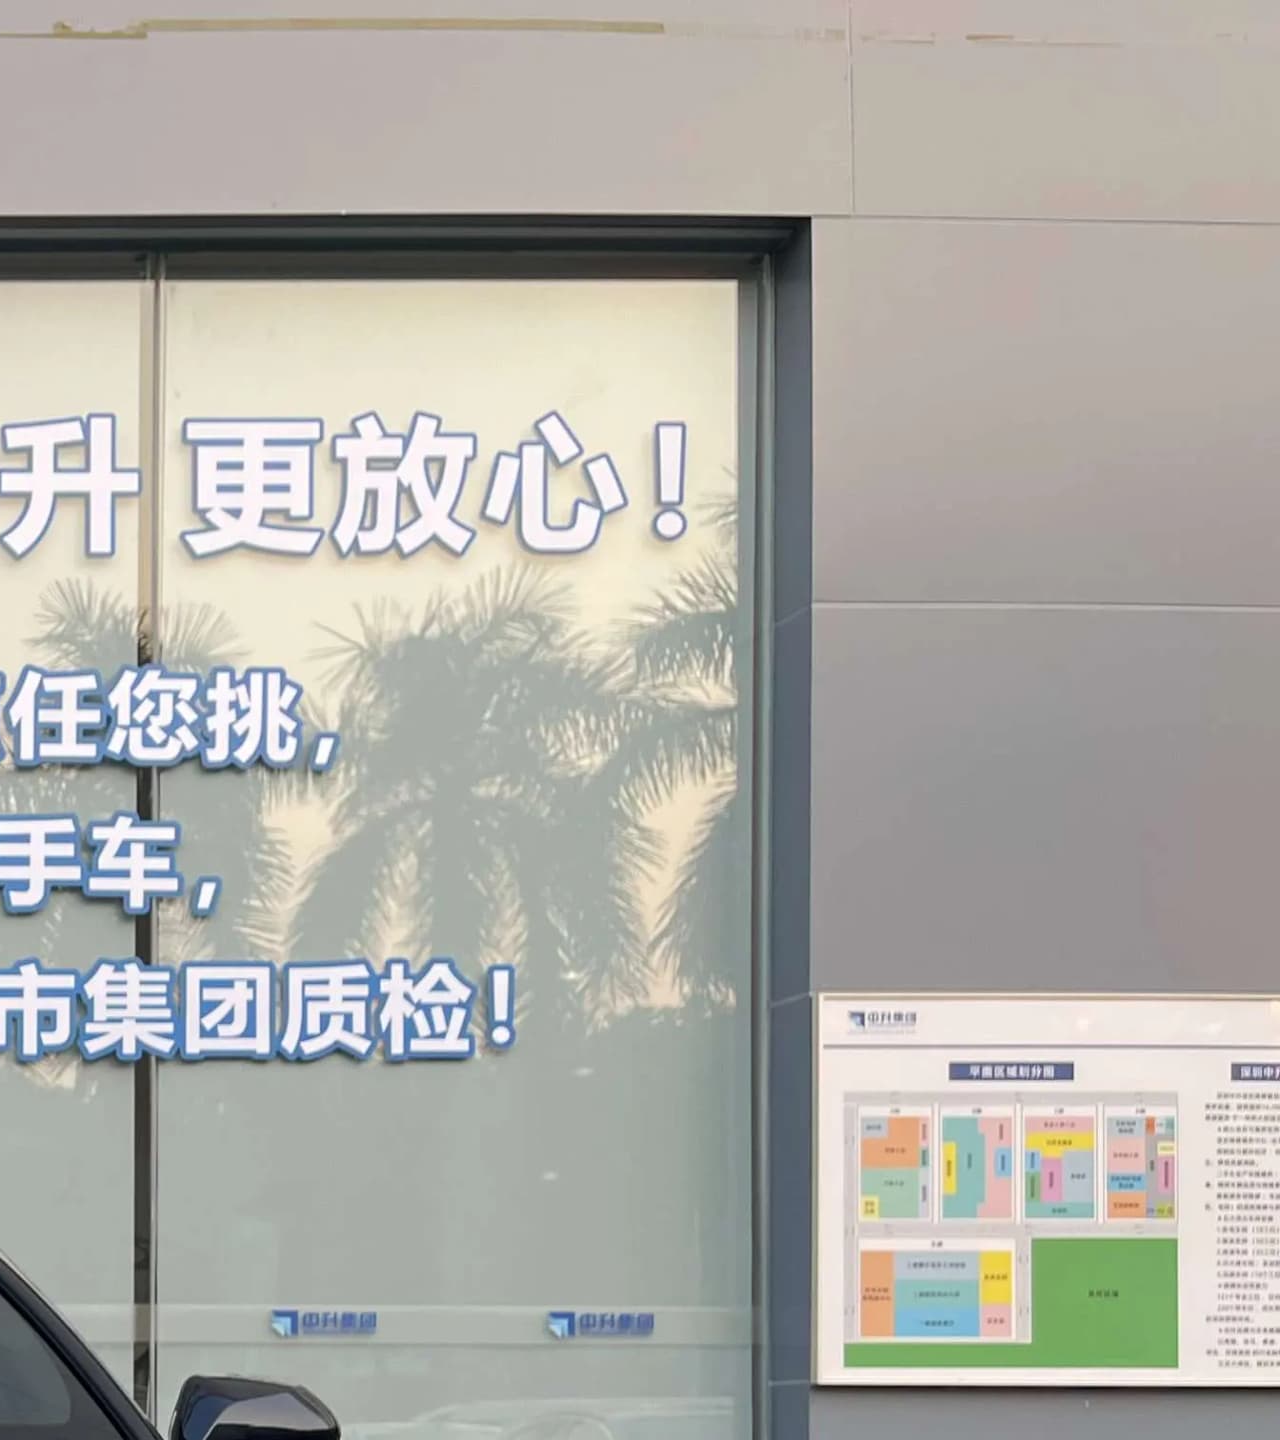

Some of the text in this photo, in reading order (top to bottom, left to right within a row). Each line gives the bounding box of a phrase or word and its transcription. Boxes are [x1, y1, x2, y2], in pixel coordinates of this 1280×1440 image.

[302, 1311, 377, 1329] 中升集团
[579, 1311, 654, 1329] 中升集团
